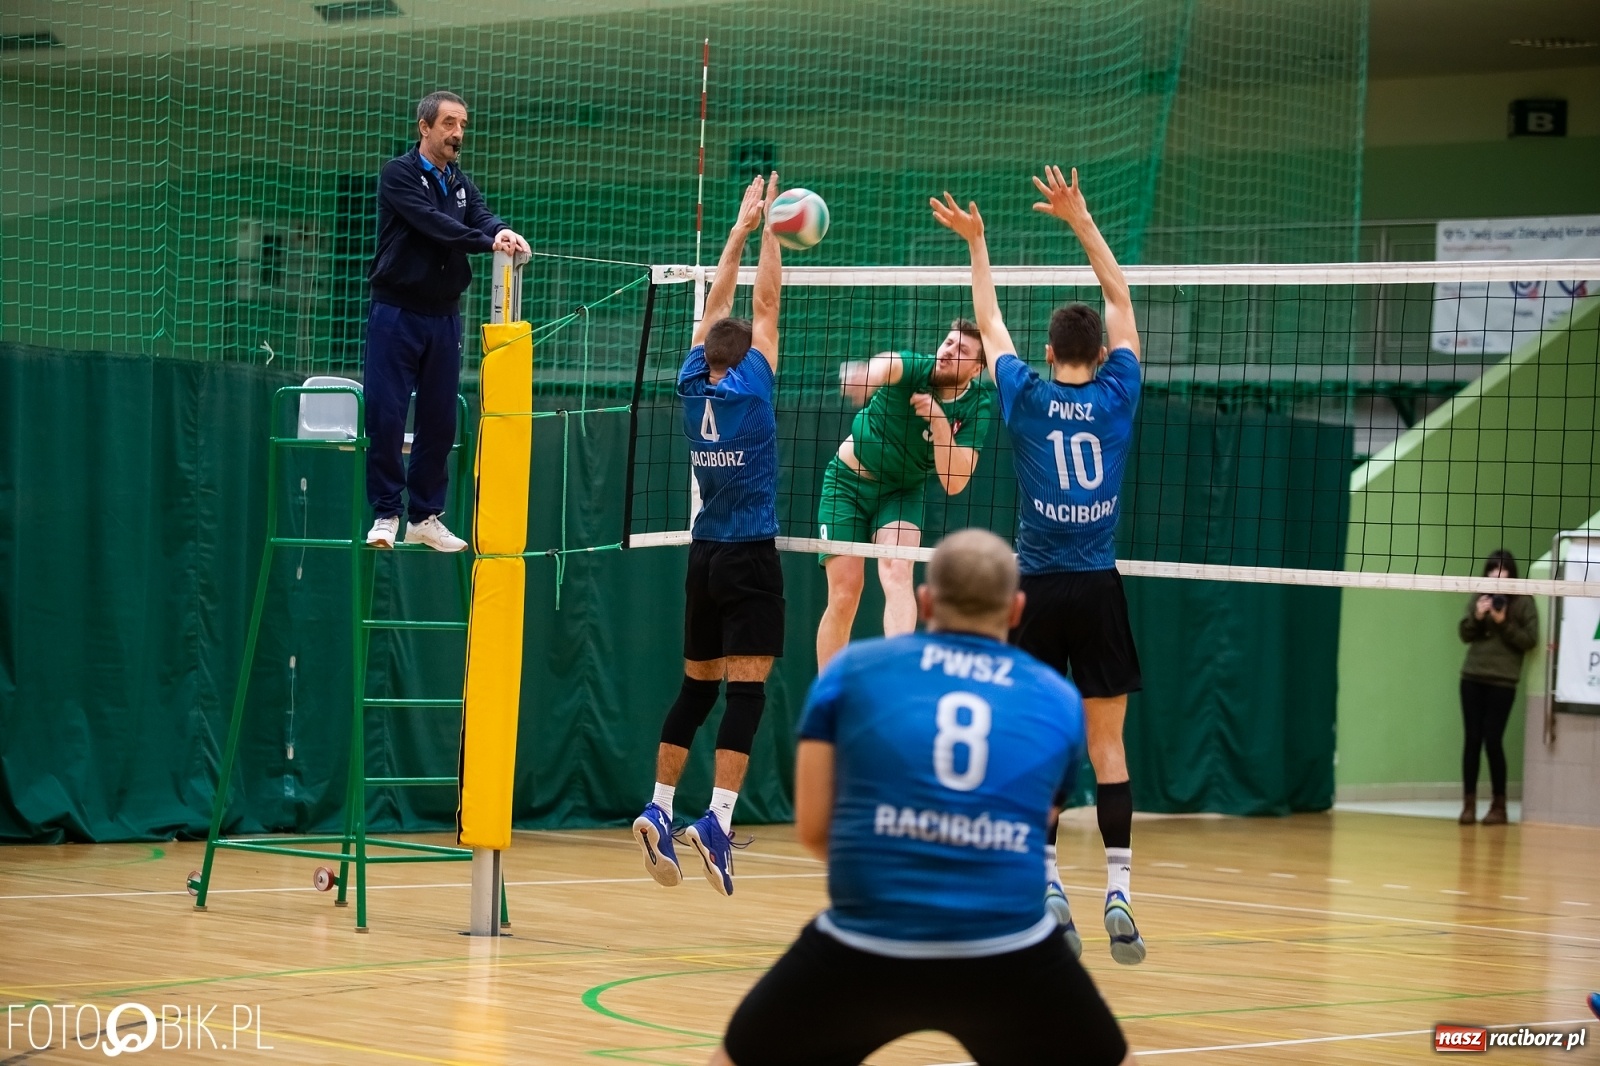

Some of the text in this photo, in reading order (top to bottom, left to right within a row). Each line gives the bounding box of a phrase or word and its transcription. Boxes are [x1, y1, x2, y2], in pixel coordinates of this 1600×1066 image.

[1527, 112, 1554, 132] B
[700, 398, 720, 443] 4
[1048, 400, 1095, 422] PWSZ
[1046, 430, 1104, 491] 10
[920, 643, 1014, 687] PWSZ
[932, 691, 992, 792] 8
[873, 803, 1031, 854] RACIBÓRZ
